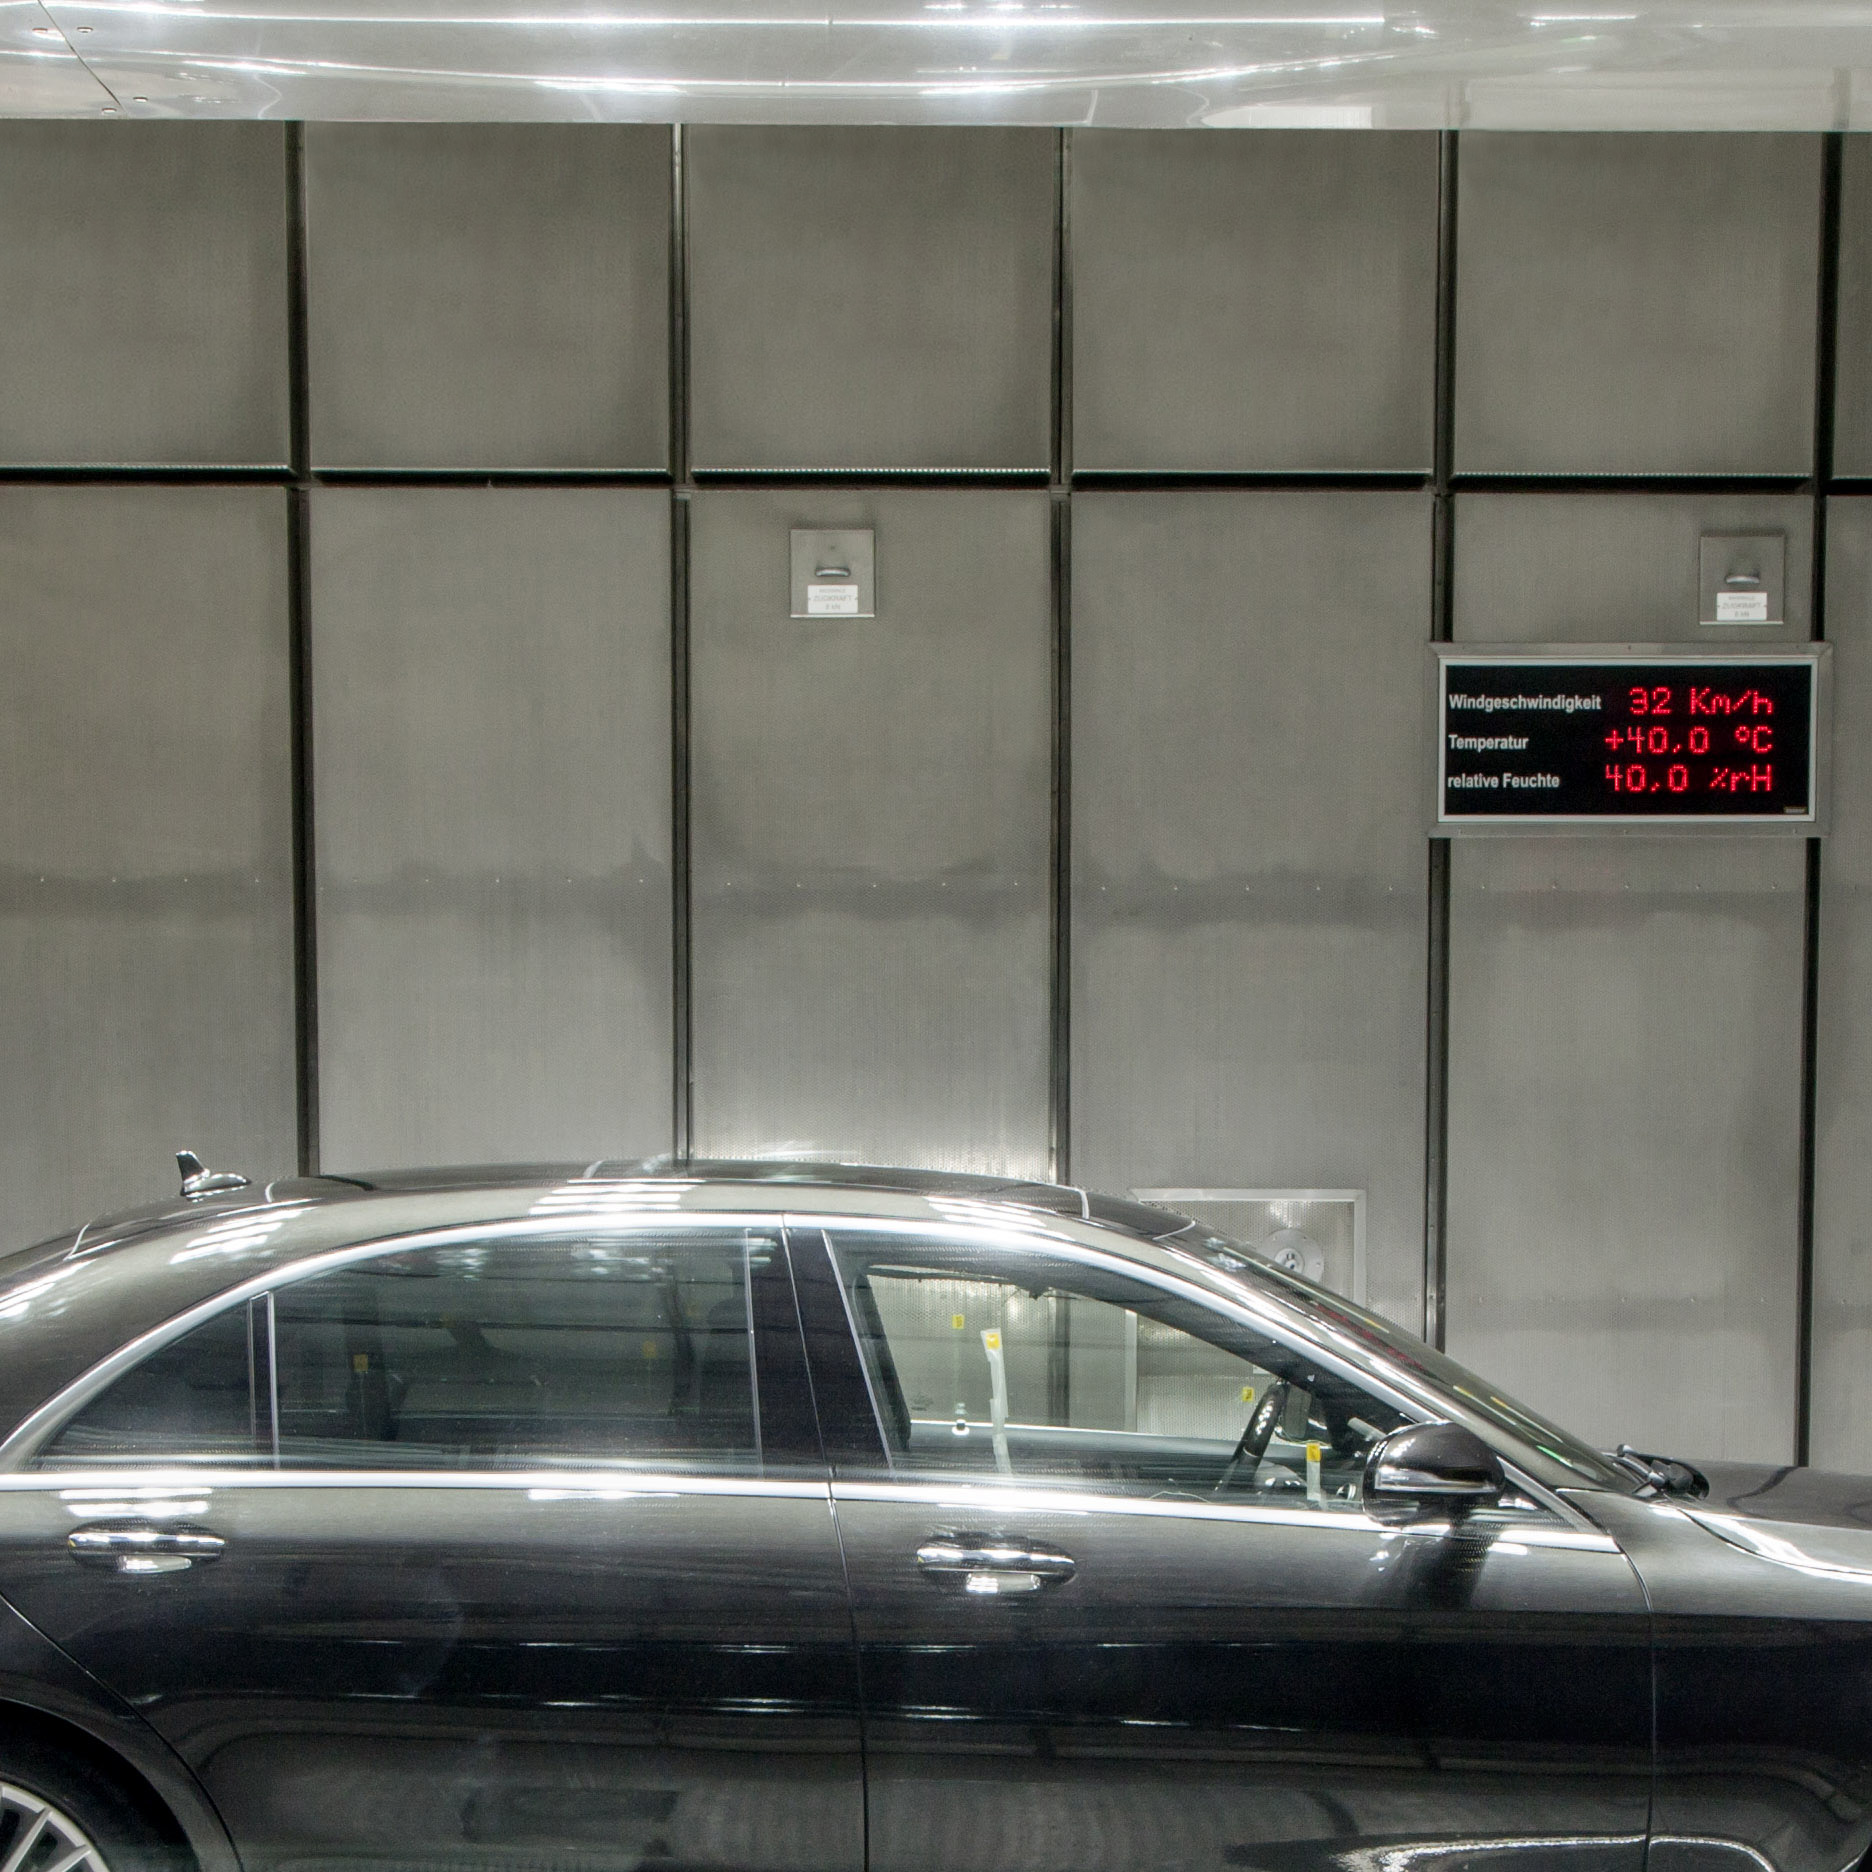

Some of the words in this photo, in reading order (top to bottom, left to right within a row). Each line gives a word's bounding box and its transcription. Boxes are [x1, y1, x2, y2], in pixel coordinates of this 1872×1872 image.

[1448, 694, 1602, 713] Windgeschwindigkeit
[1630, 687, 1671, 715] 32
[1690, 687, 1774, 715] Km/h
[1448, 733, 1529, 753] Temperatur
[1605, 726, 1710, 754] +40,0
[1735, 726, 1773, 753] °C
[1447, 773, 1499, 788] relative
[1502, 773, 1560, 788] Feuchte
[1605, 764, 1689, 792] 40,0
[1710, 764, 1772, 792] %rH
